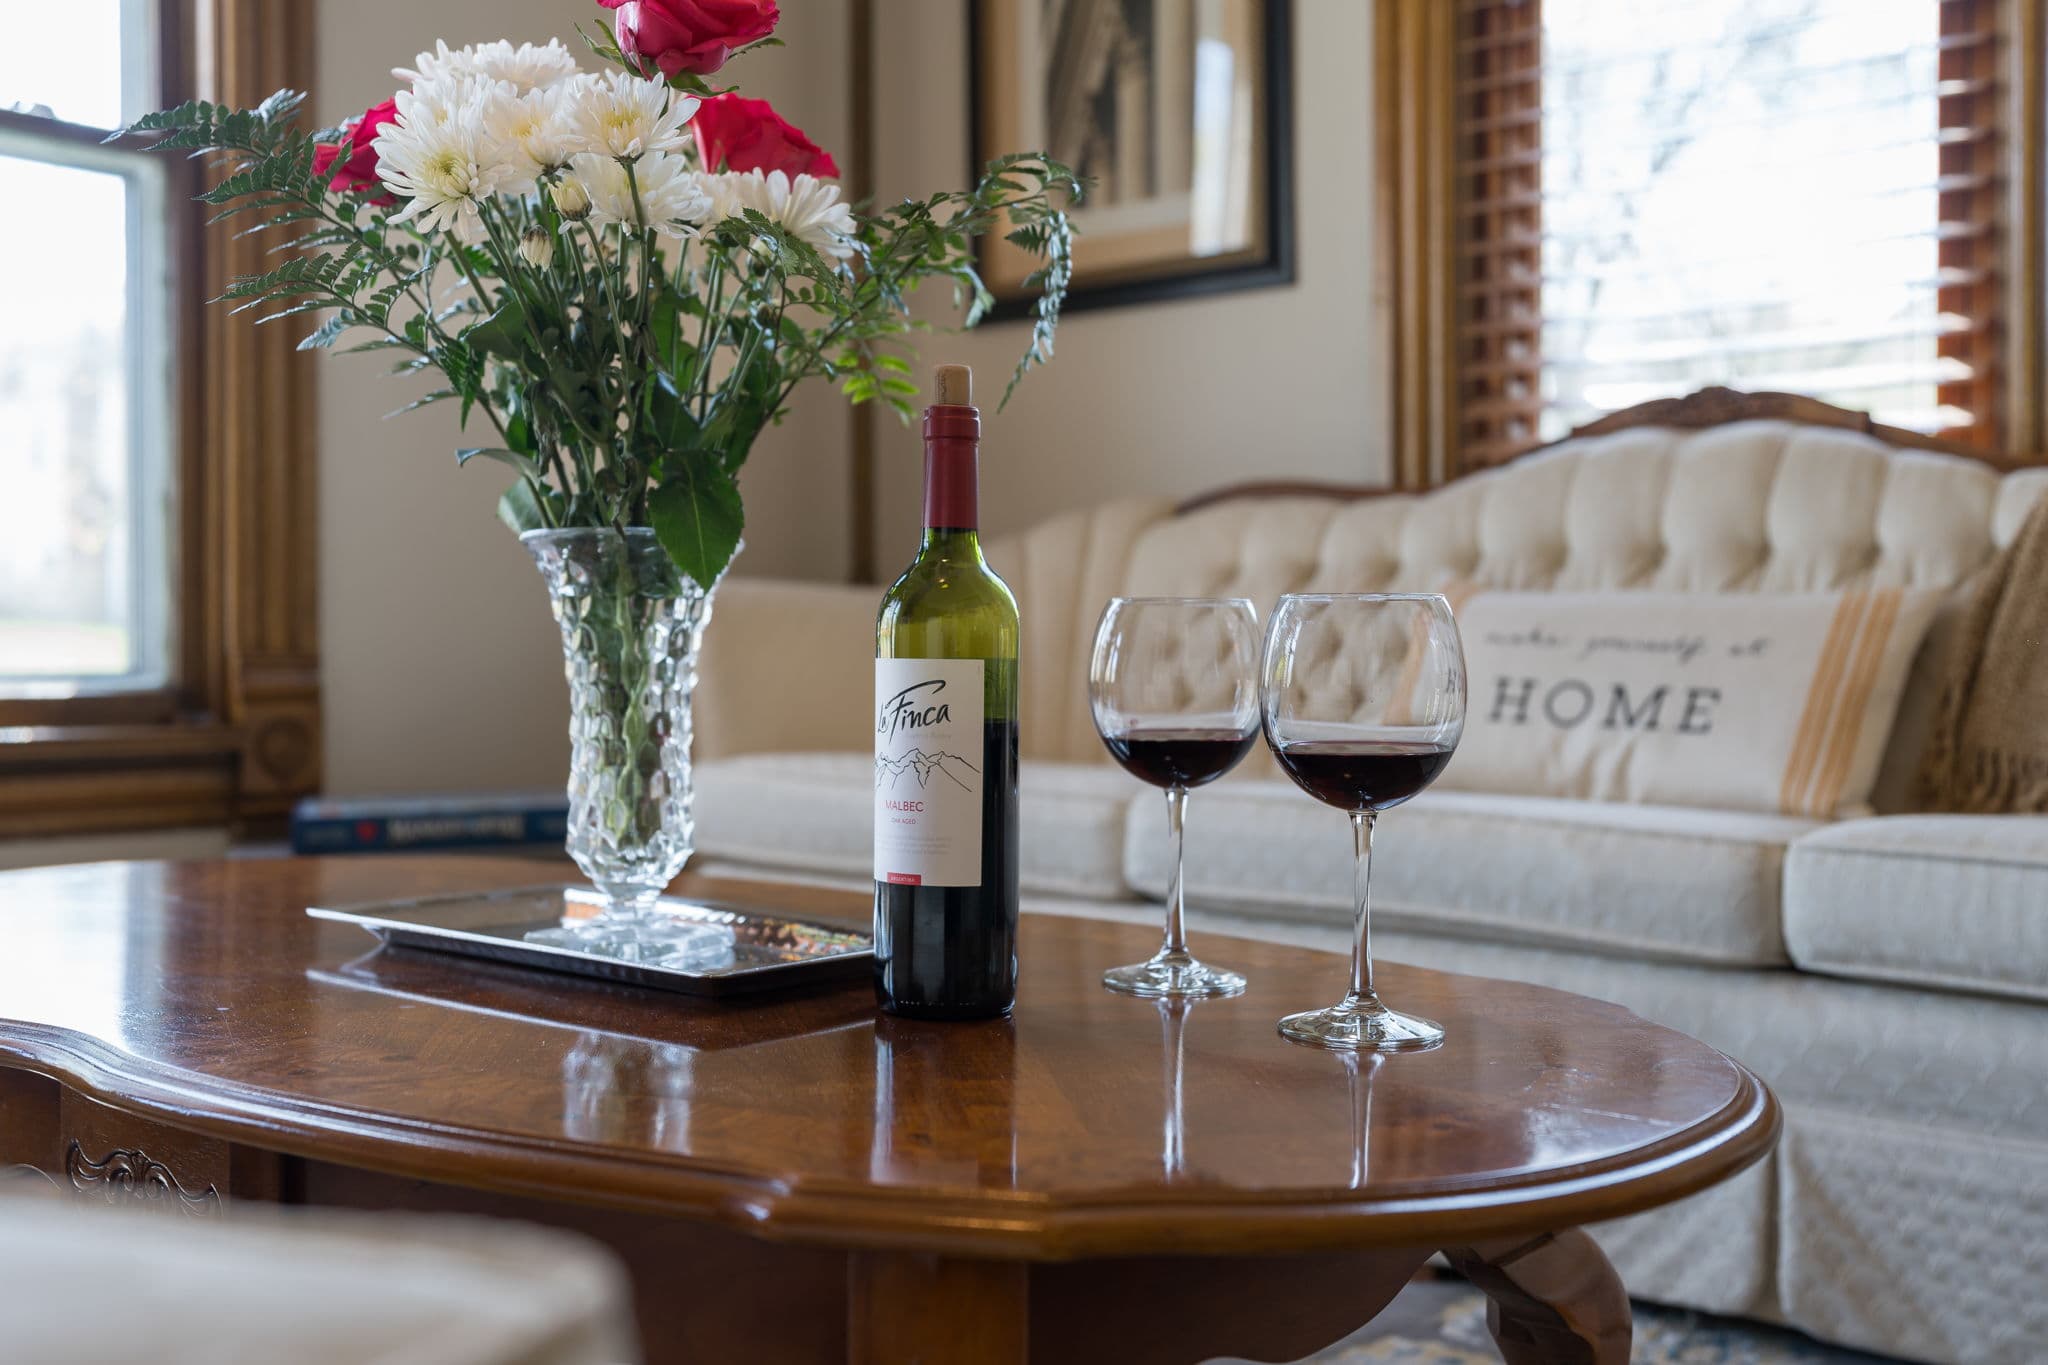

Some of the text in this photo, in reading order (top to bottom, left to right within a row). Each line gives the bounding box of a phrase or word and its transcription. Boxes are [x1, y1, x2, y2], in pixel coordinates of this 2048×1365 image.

[884, 679, 952, 745] Finca
[1488, 675, 1724, 736] HOME
[885, 800, 924, 812] MALBEC
